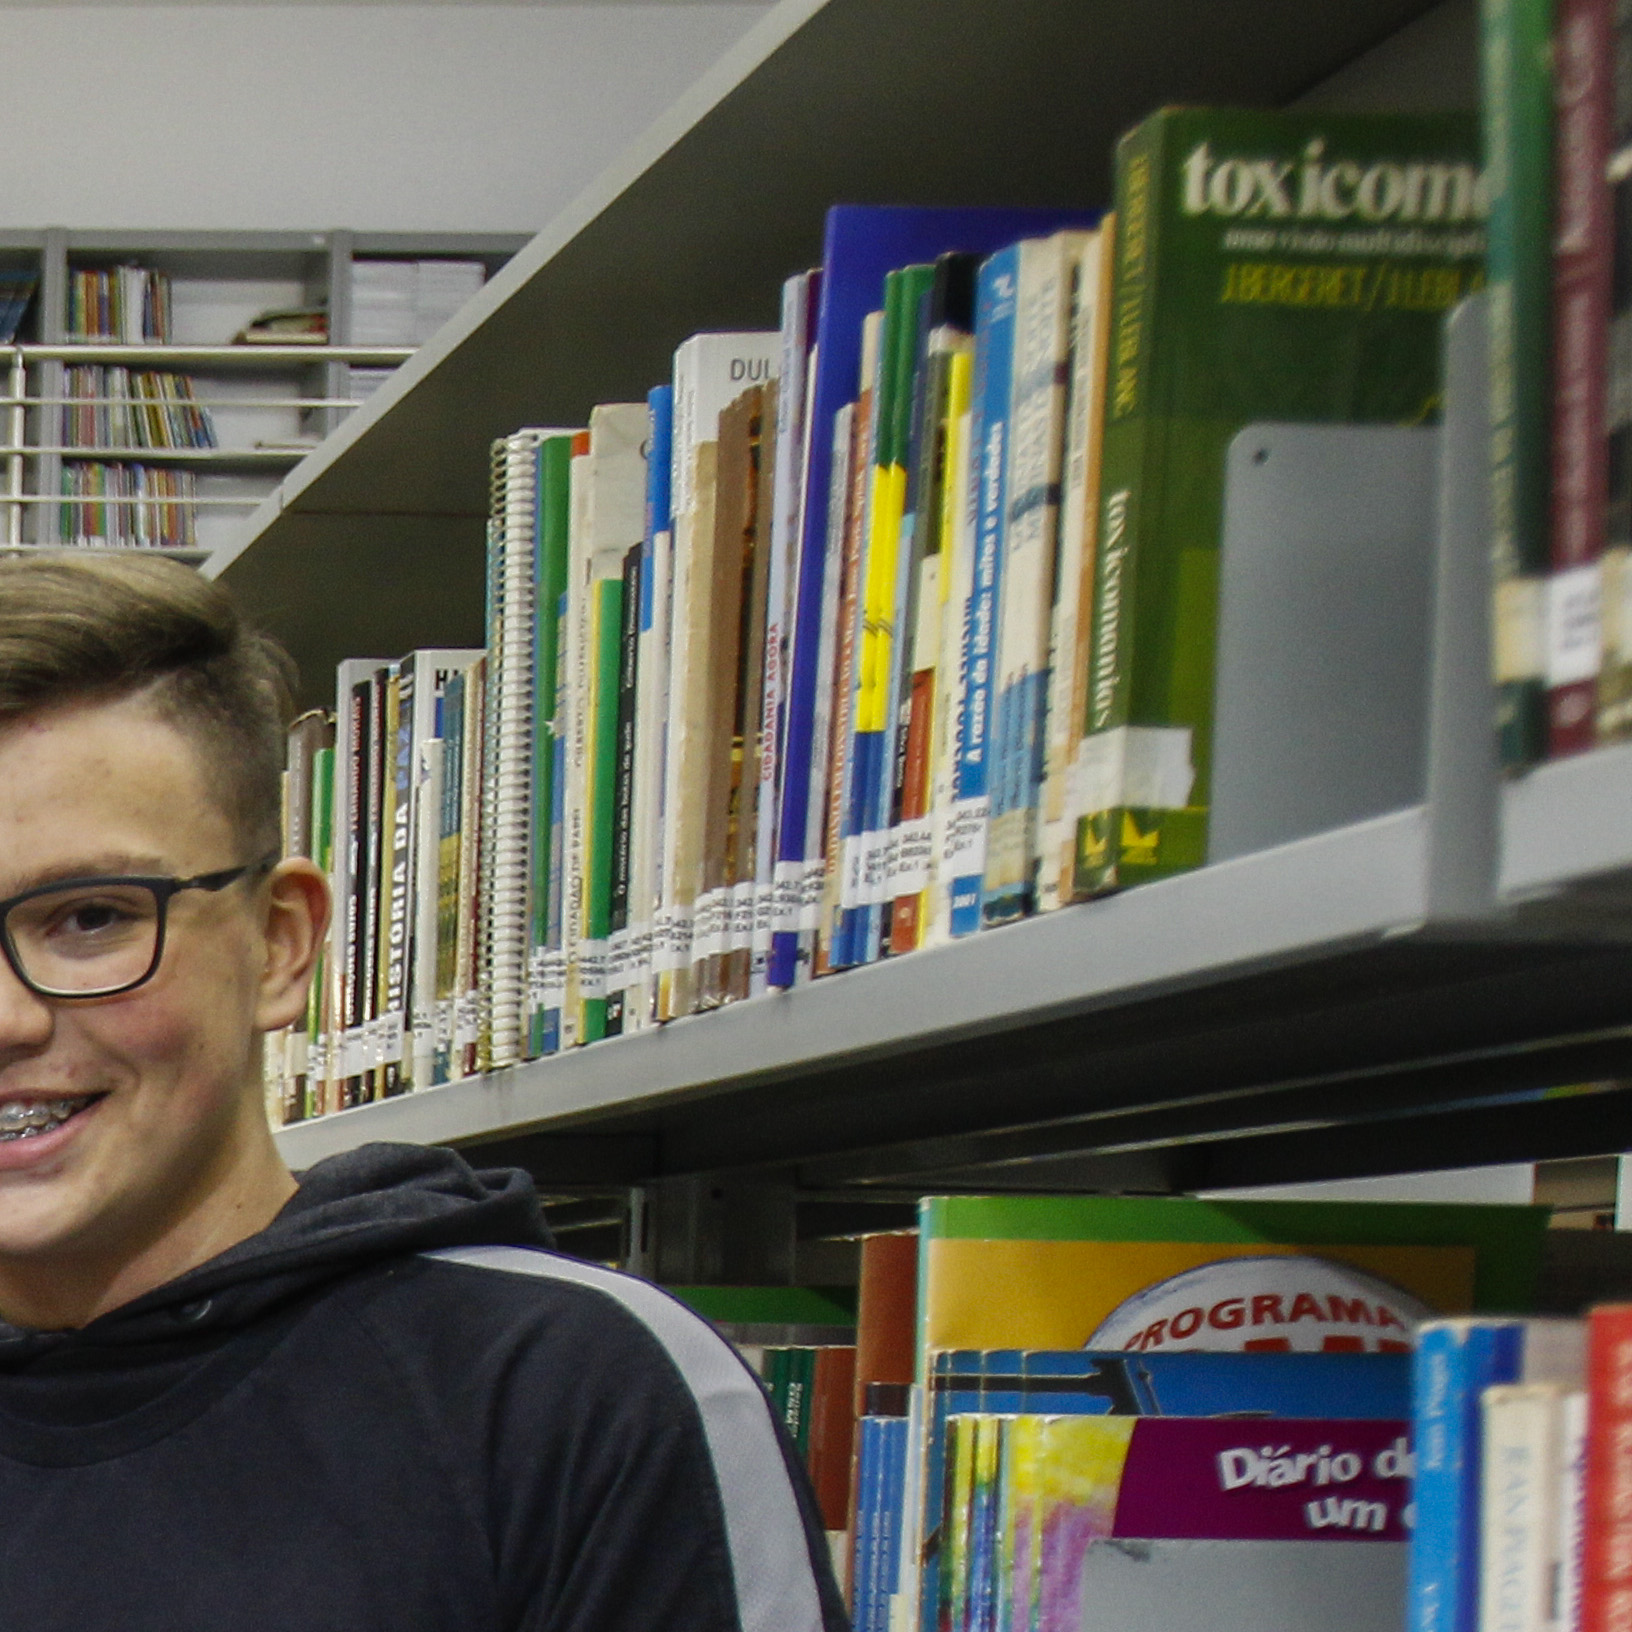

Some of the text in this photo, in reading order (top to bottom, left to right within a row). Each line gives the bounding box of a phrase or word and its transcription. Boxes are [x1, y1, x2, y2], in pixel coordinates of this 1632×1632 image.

[393, 802, 408, 850] DA
[1218, 1444, 1362, 1491] Diário
[1306, 1496, 1387, 1531] um
